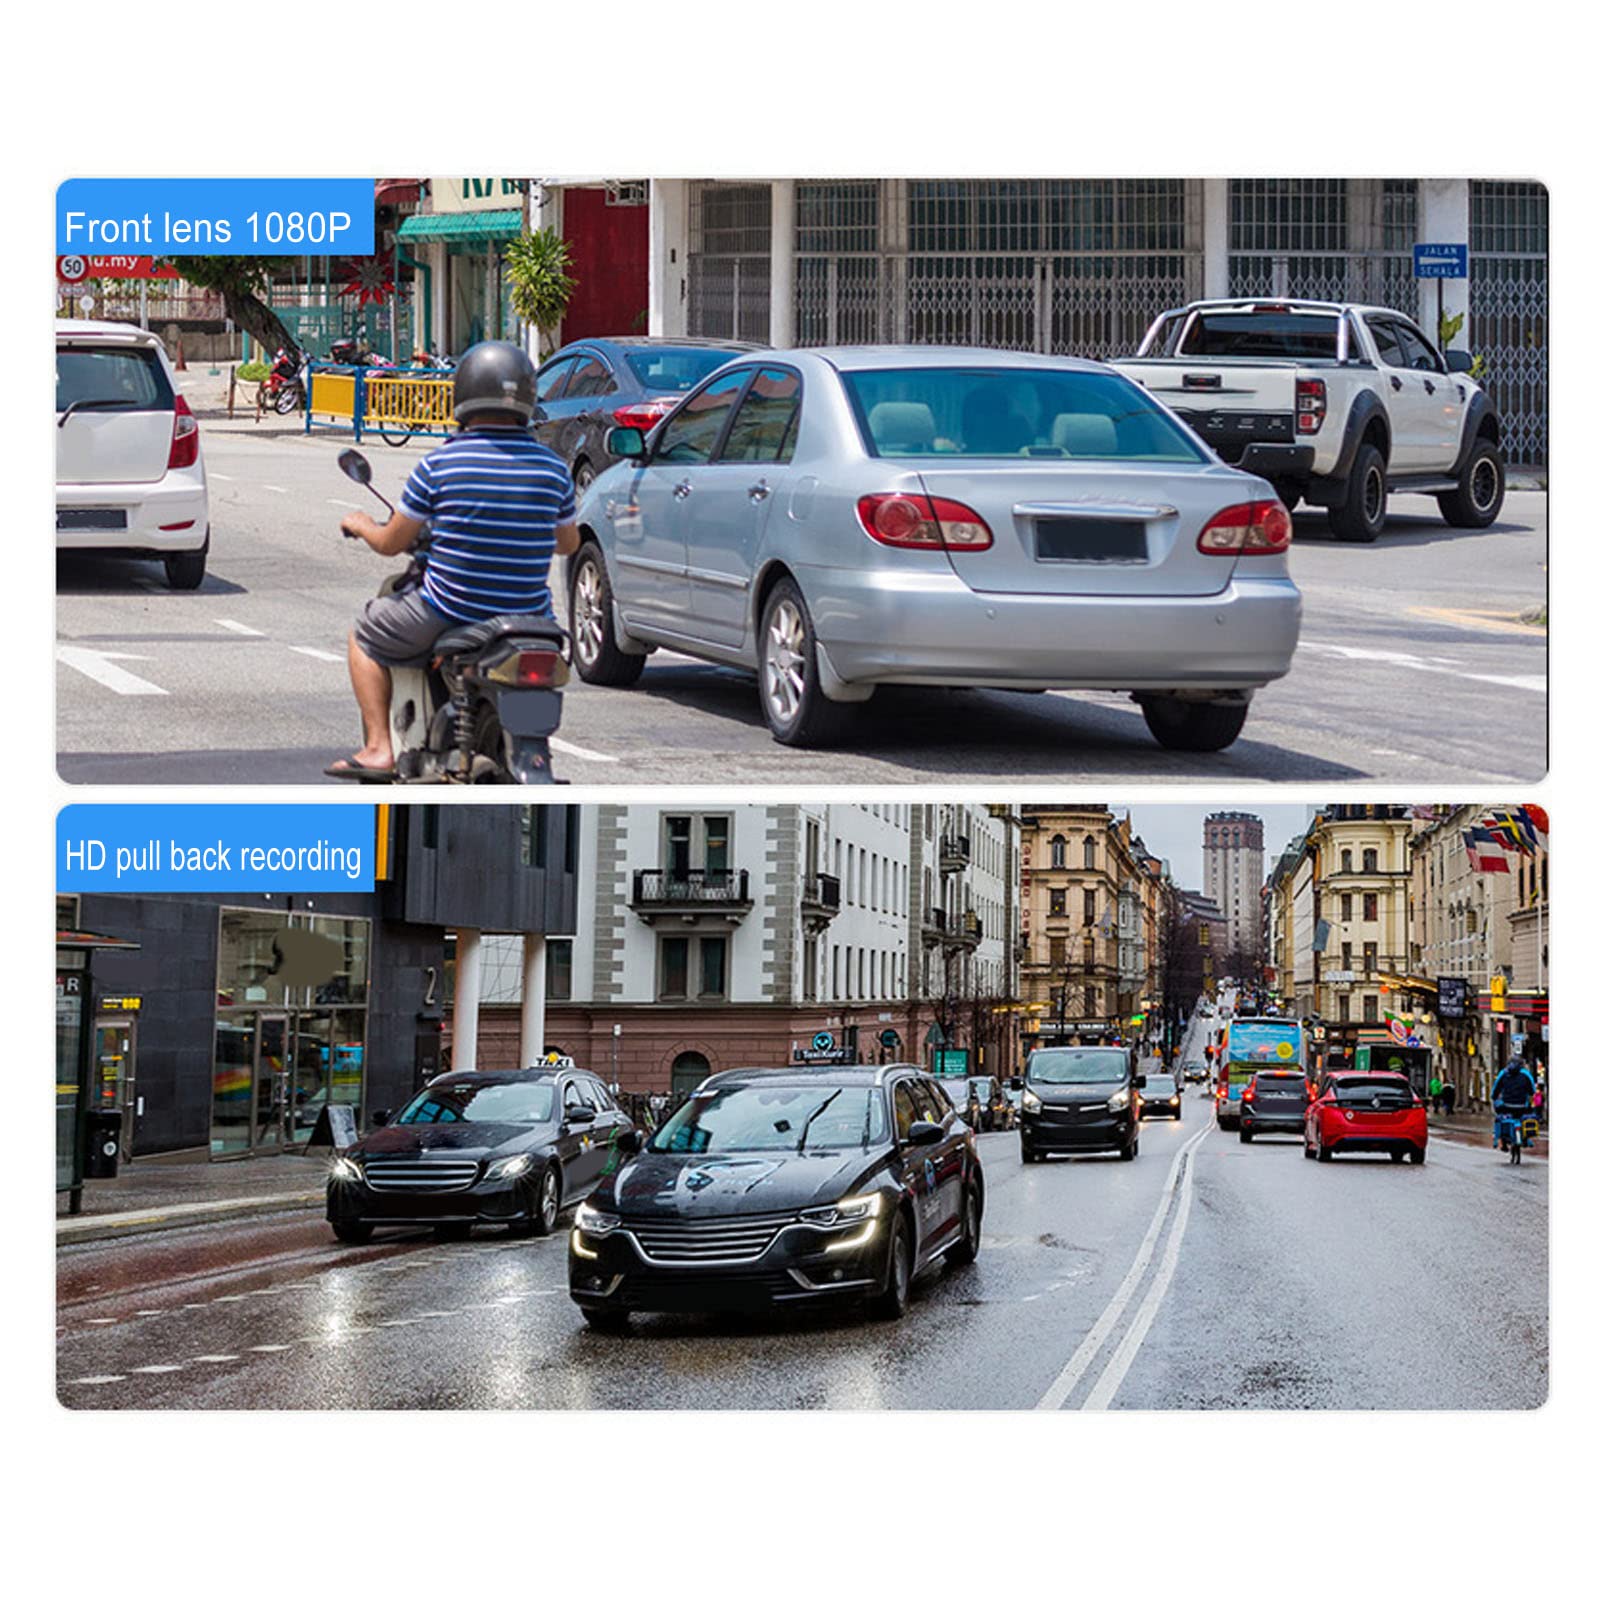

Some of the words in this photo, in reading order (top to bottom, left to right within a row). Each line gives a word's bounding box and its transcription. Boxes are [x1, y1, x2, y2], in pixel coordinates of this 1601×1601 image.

[1424, 247, 1457, 256] JALAN
[64, 259, 83, 274] 50
[1420, 266, 1460, 276] SEHALA
[67, 977, 79, 991] R
[424, 966, 437, 1004] 2
